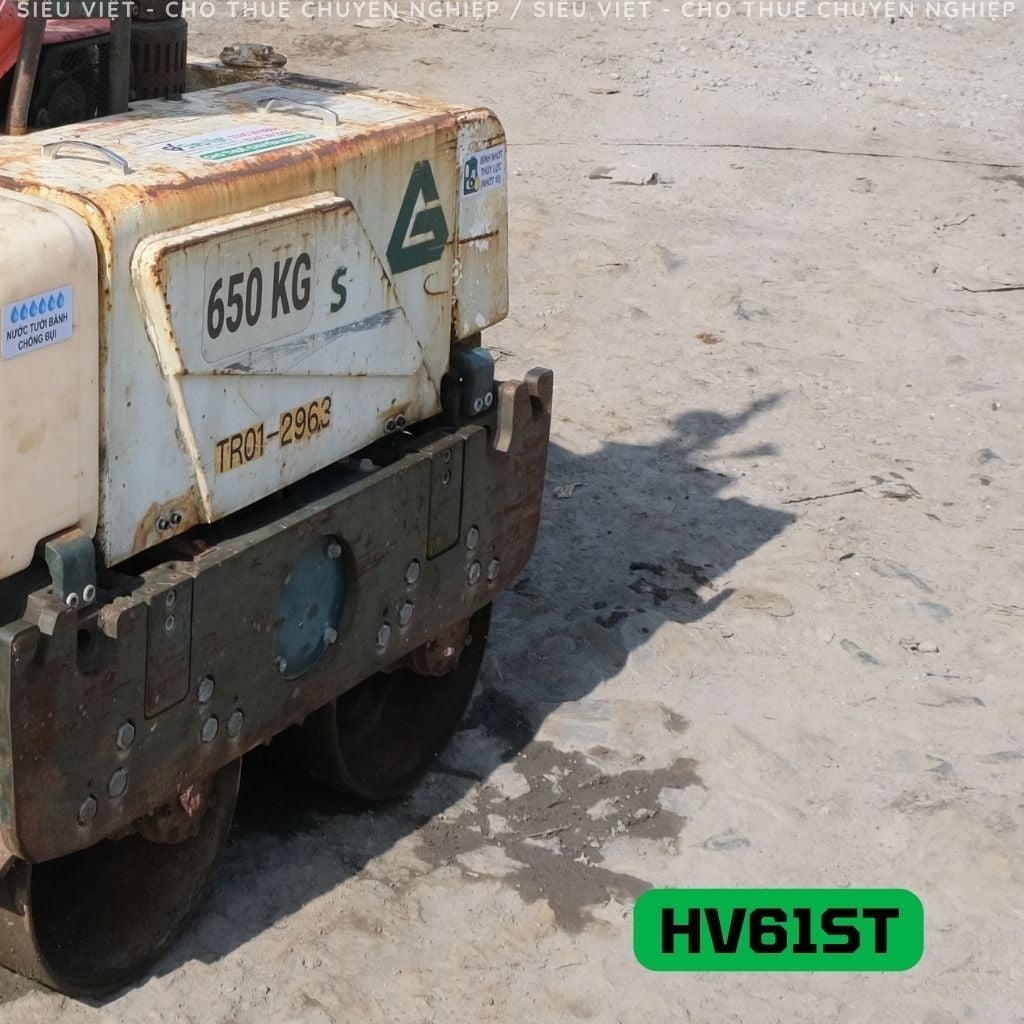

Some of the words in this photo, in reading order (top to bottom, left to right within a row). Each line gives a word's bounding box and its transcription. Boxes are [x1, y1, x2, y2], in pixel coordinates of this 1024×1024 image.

[207, 267, 262, 339] 650
[271, 252, 312, 319] KG
[215, 395, 332, 474] TR01-2963
